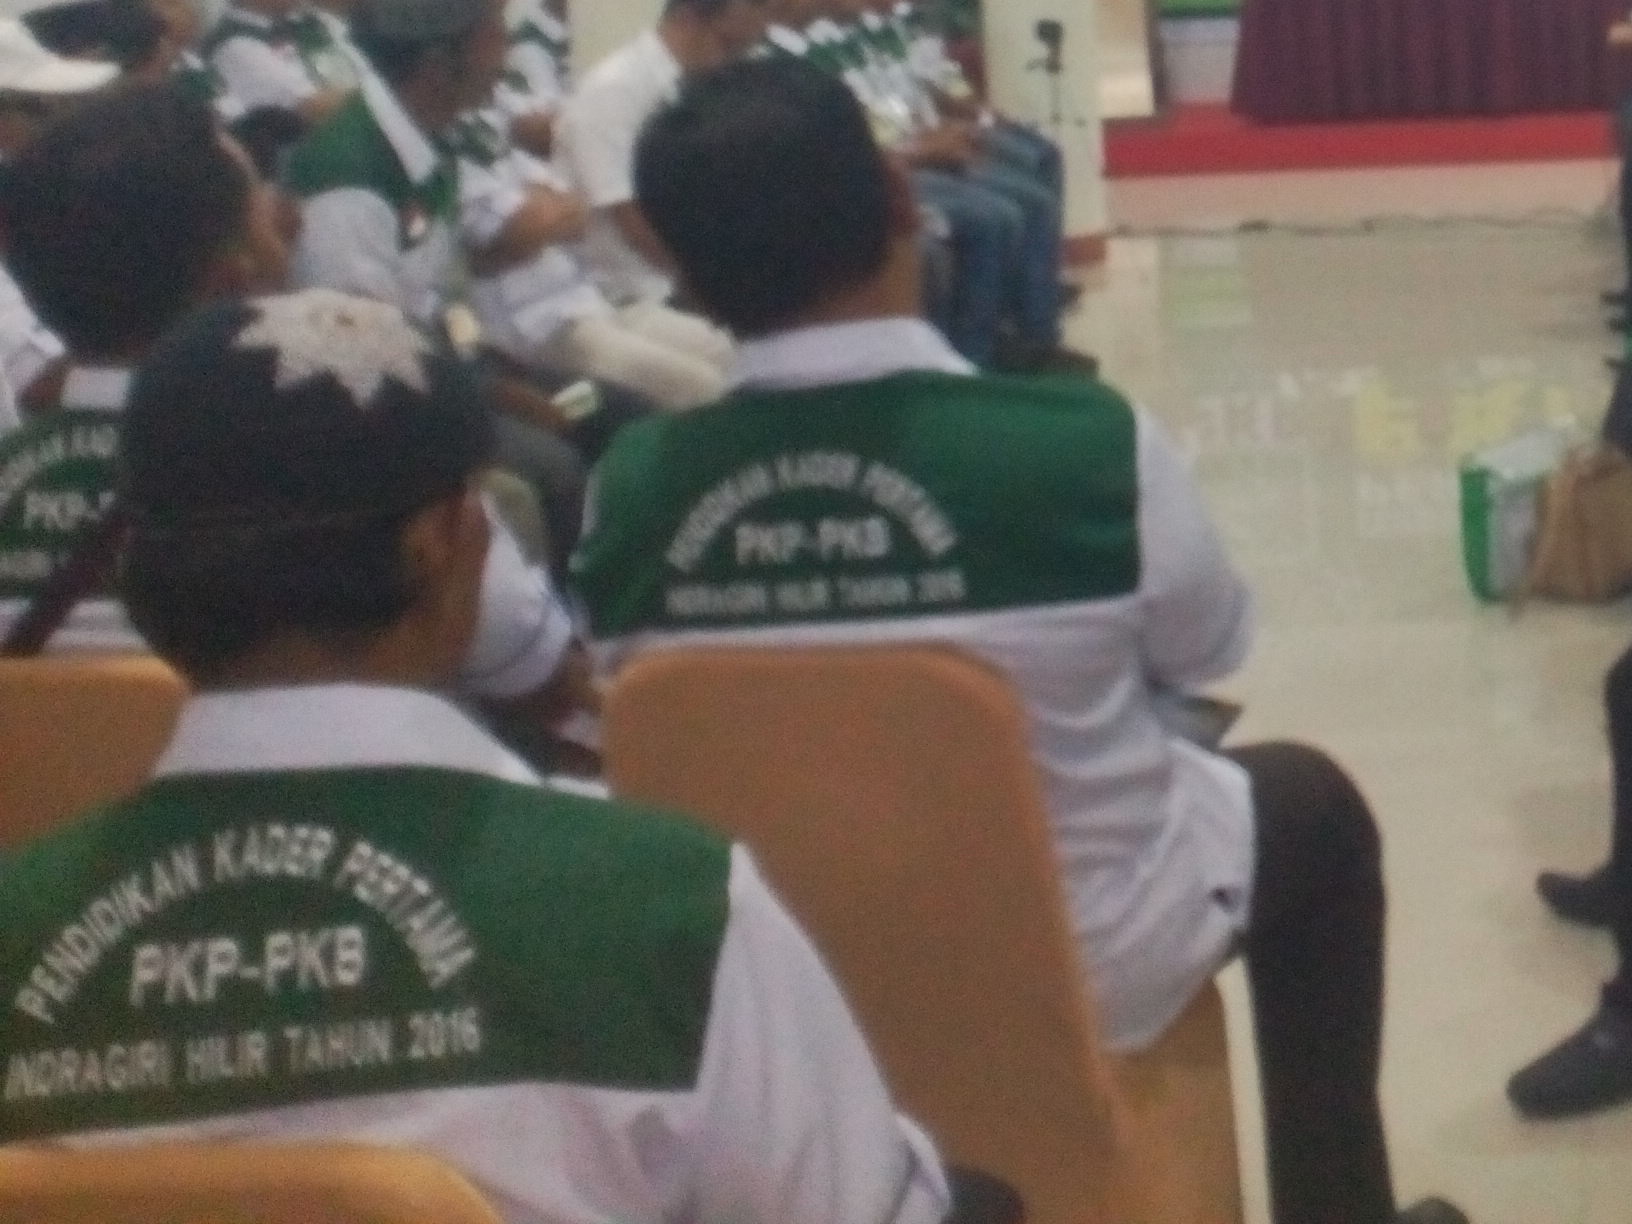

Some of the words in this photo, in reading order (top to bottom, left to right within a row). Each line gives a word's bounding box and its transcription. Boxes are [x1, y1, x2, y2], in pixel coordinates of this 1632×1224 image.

[13, 841, 202, 1024] PENDIDIKAN
[210, 821, 338, 882] KADER
[333, 839, 480, 989] PERTAMA
[128, 925, 366, 1007] PKP-PKB
[282, 1019, 393, 1075] TAHUN
[405, 1005, 483, 1060] 2016
